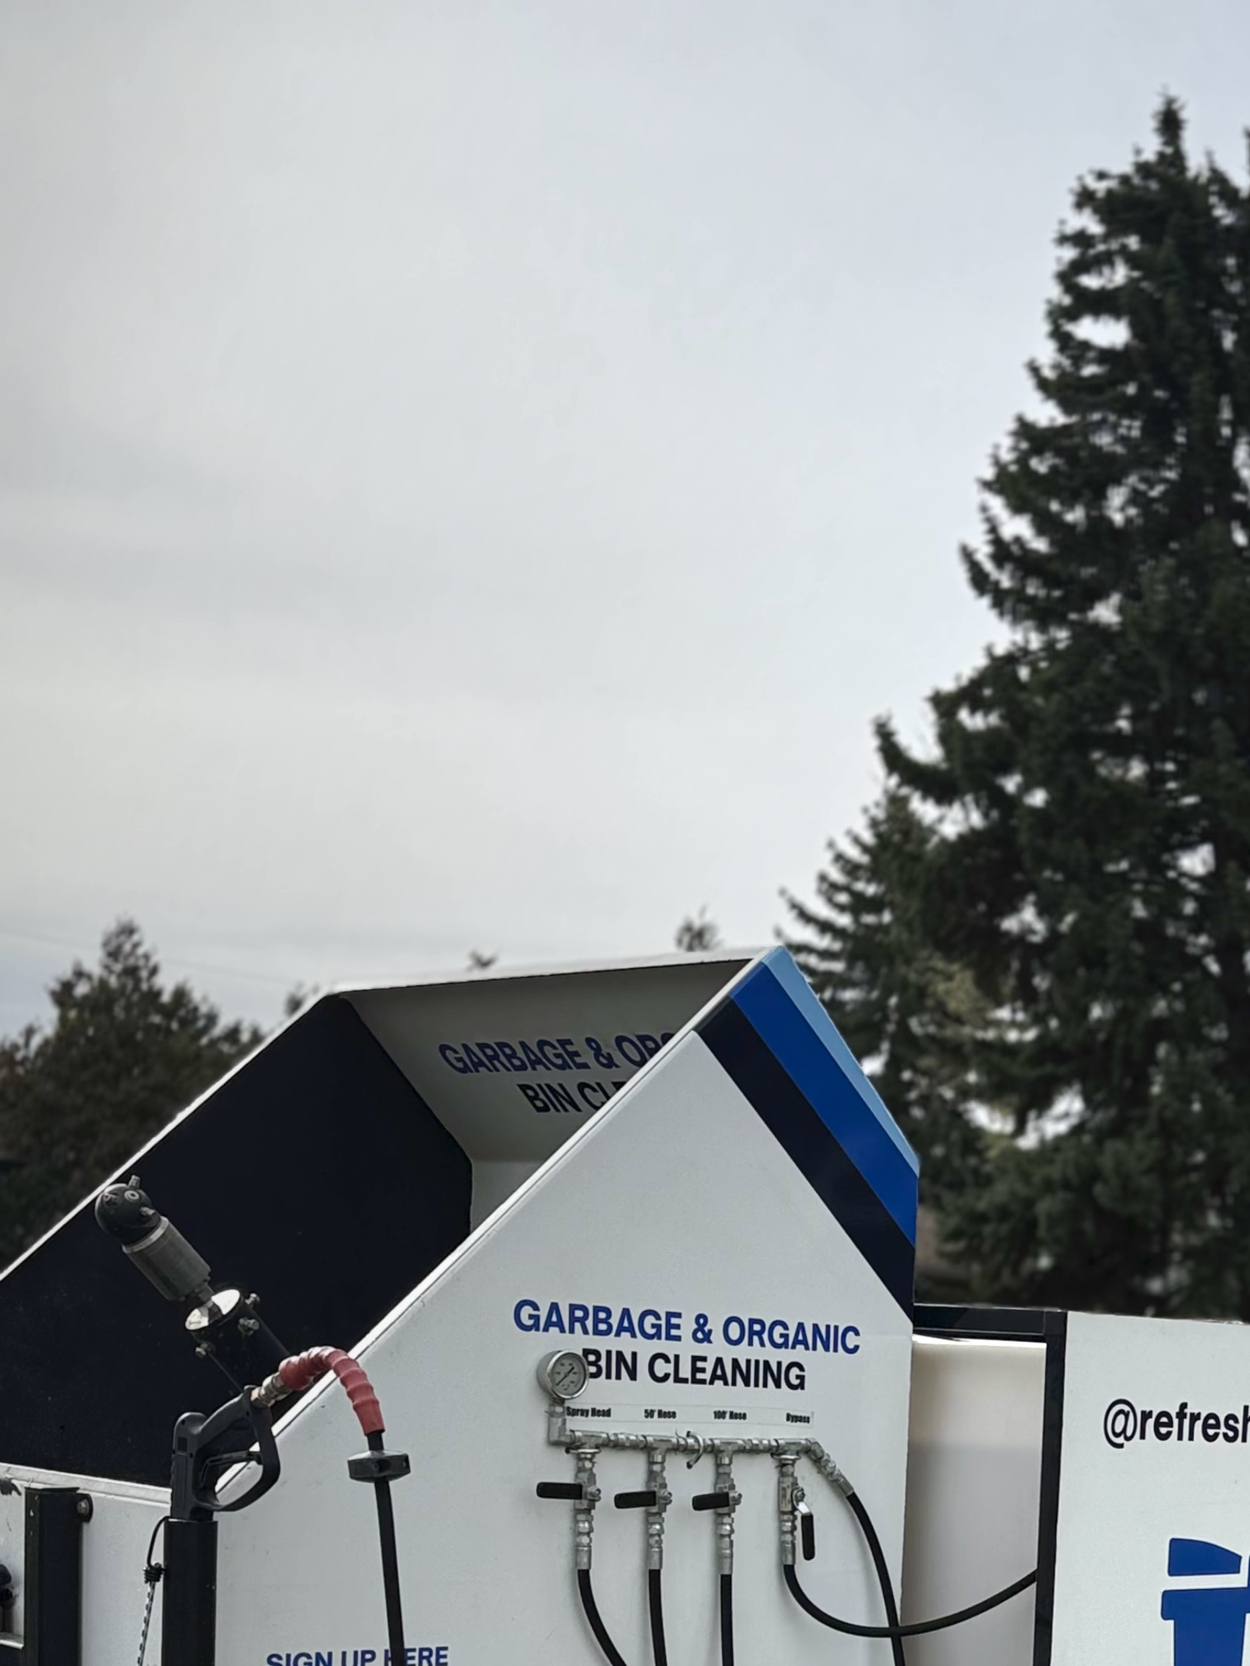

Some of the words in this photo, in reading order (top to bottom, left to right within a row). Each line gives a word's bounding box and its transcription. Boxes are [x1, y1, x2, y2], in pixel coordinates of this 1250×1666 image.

[438, 1038, 591, 1074] GARBAGE
[584, 1036, 621, 1069] &
[516, 1083, 583, 1113] BIN
[513, 1299, 682, 1342] GARBAGE
[691, 1313, 713, 1345] &
[722, 1315, 861, 1354] ORGANIC
[582, 1348, 638, 1382] BIN
[648, 1352, 806, 1391] CLEANING
[566, 1407, 589, 1419] Spray
